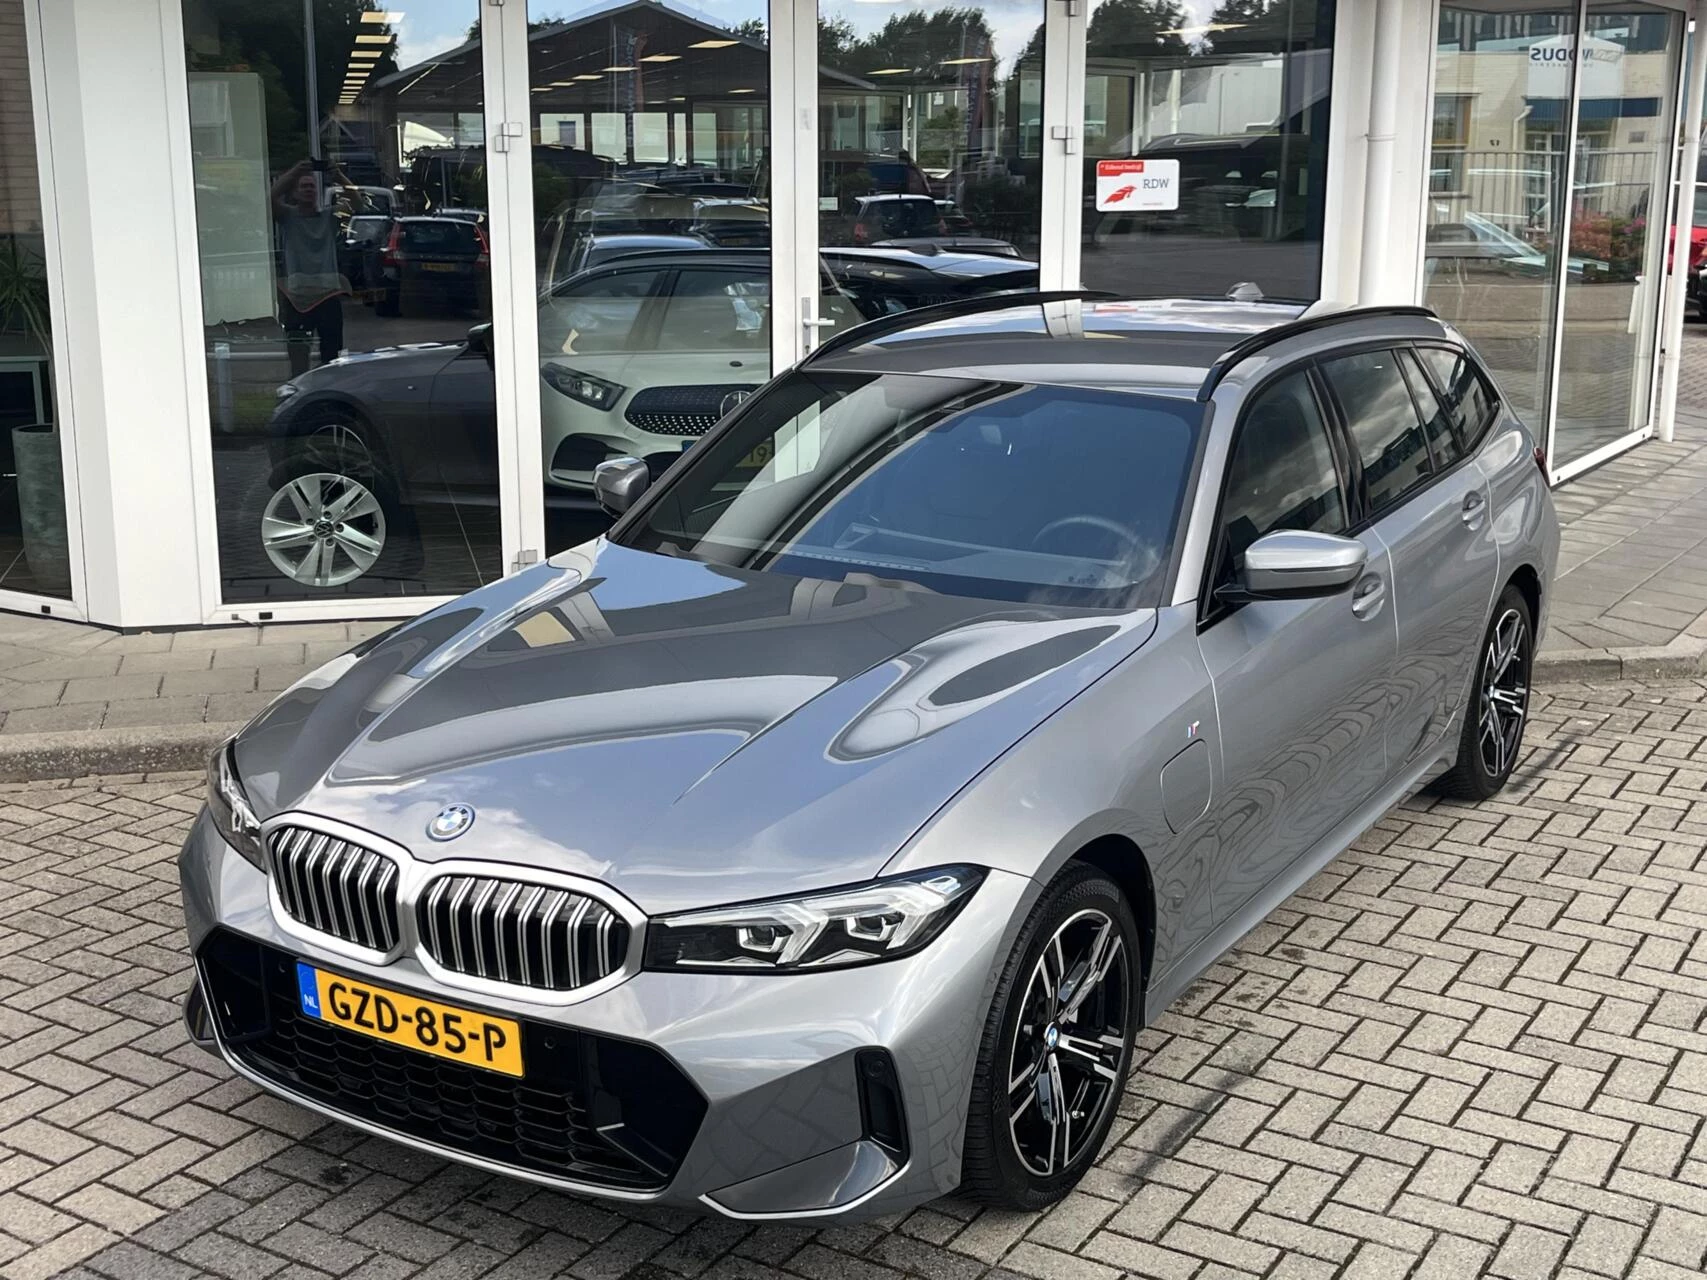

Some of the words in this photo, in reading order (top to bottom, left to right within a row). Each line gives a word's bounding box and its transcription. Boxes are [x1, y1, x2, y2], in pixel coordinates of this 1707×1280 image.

[1143, 178, 1170, 189] RDW
[303, 994, 319, 1009] NL
[328, 981, 506, 1062] GZD-85-P
